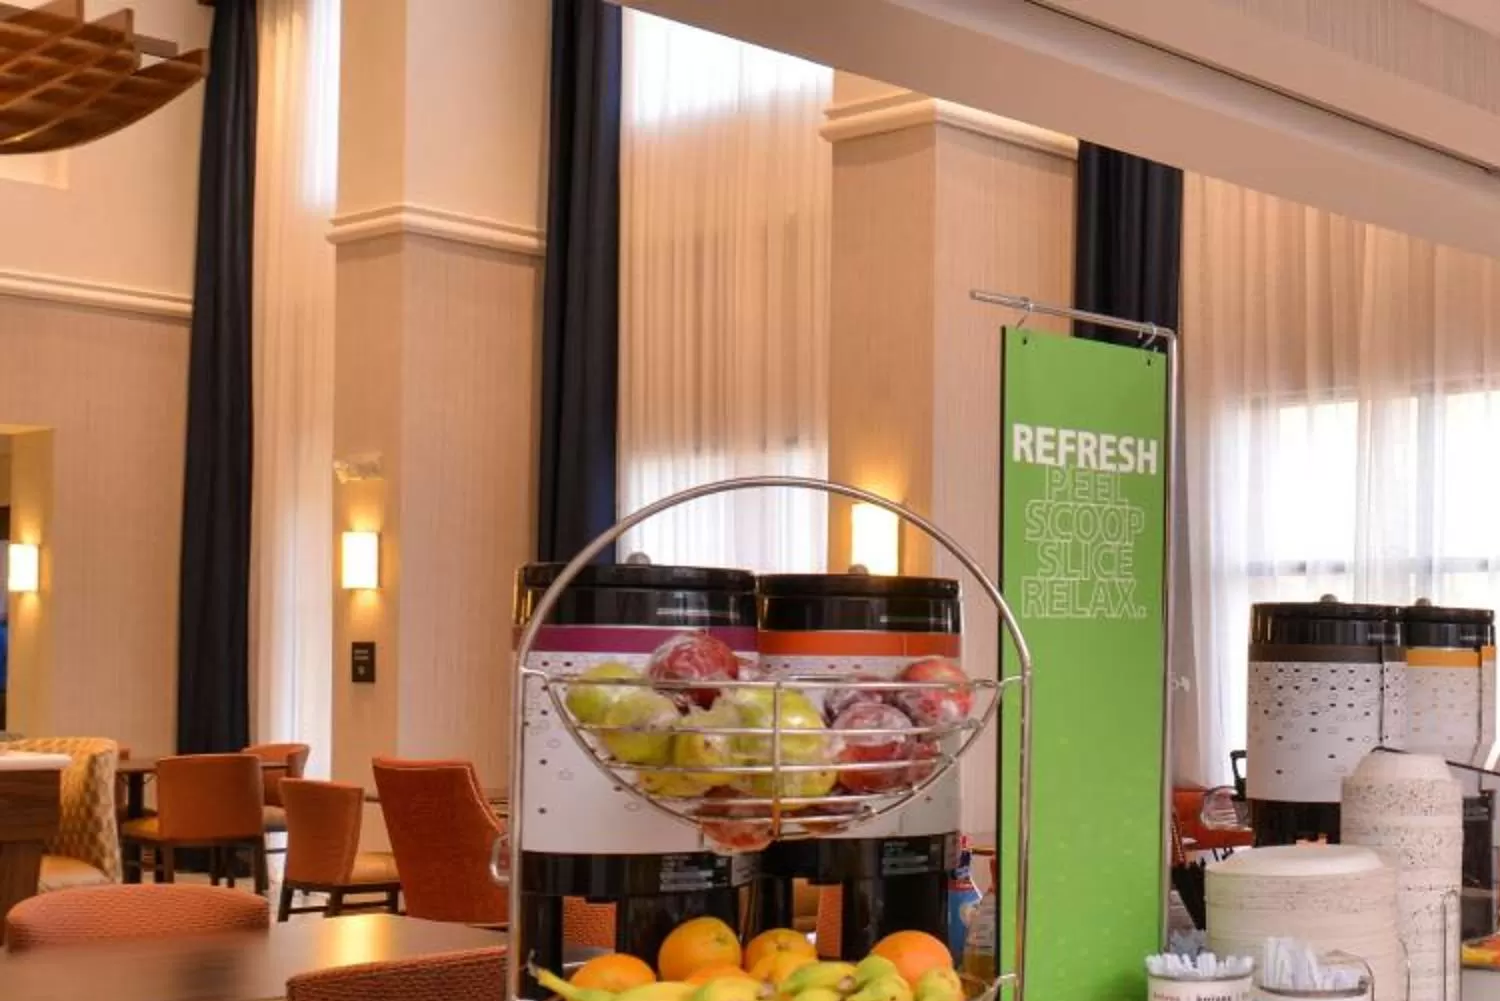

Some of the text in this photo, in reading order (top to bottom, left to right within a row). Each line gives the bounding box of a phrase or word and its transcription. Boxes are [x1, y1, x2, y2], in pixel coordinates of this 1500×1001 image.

[1012, 422, 1160, 475] REFRESH
[1046, 465, 1129, 505] PEEL
[1024, 500, 1146, 546] SCOOP
[1036, 539, 1135, 582] SLICE
[1021, 576, 1148, 619] RELAX.
